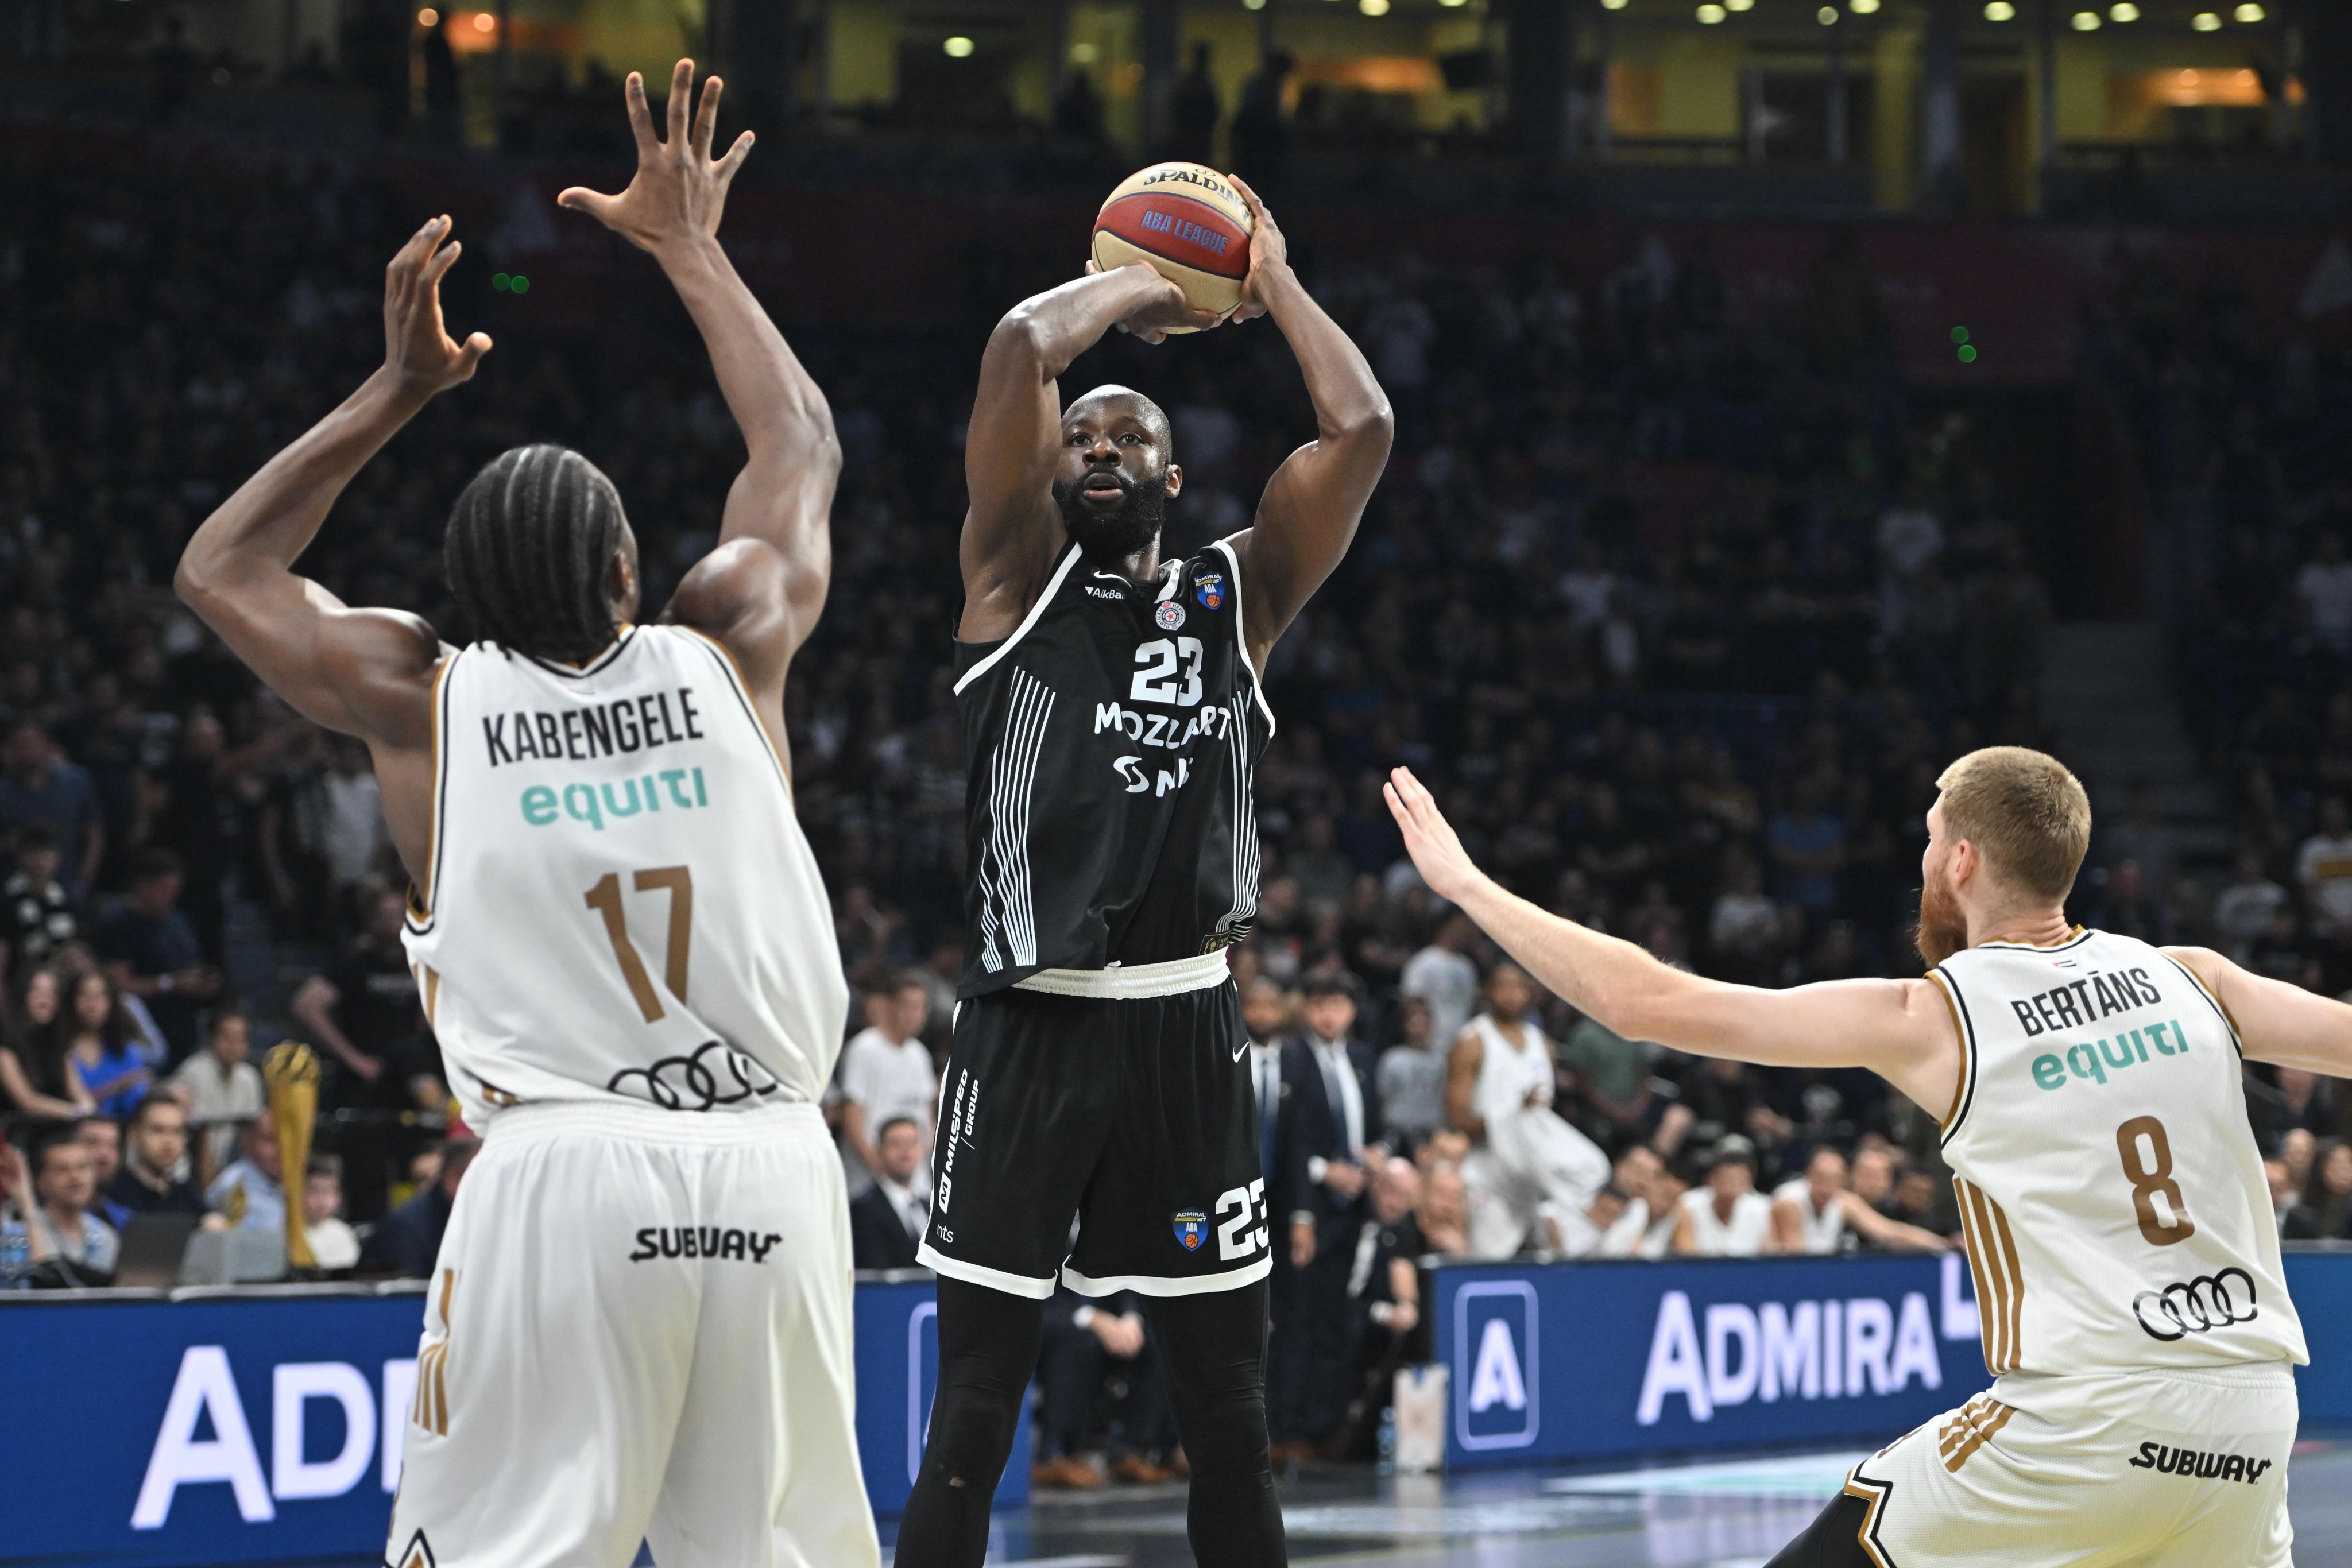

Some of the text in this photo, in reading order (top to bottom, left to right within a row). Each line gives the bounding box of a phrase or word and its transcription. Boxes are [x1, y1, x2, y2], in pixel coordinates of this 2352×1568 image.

[1141, 210, 1228, 256] ABA LEAGUE
[1092, 587, 1124, 600] AikBa
[1204, 584, 1217, 593] ABA
[1130, 637, 1203, 706] 23
[482, 688, 704, 767] KABENGELE
[520, 767, 708, 830] equiti
[584, 865, 693, 1024] 17
[2011, 967, 2161, 1037] BERTĀNS
[2032, 1020, 2189, 1090] equiti
[945, 1068, 968, 1173] MILSPED
[965, 1079, 979, 1136] GROUP
[2116, 1116, 2195, 1246] 8
[629, 1226, 782, 1263] SUBWAY
[1186, 1222, 1198, 1232] ABA
[1469, 1318, 1527, 1413] A
[2128, 1441, 2272, 1485] SUBWAY
